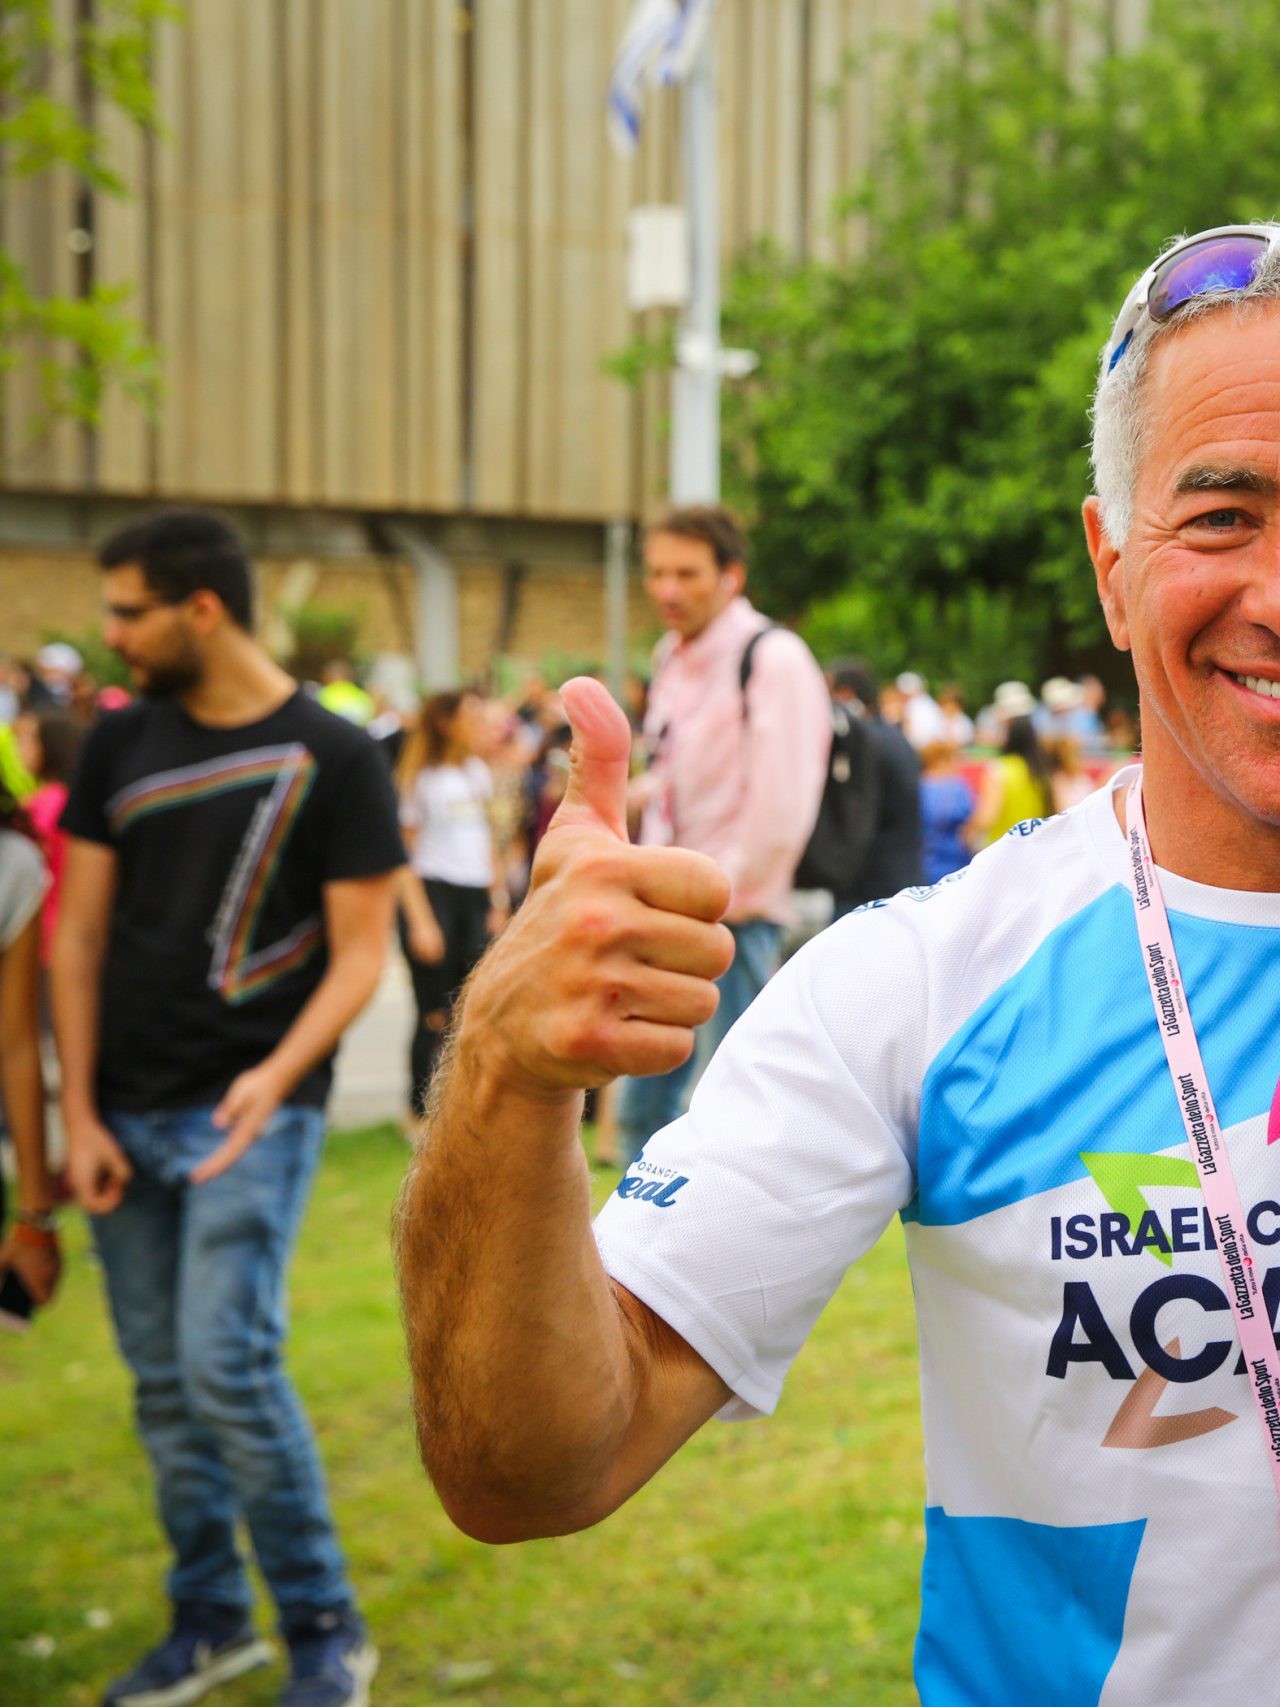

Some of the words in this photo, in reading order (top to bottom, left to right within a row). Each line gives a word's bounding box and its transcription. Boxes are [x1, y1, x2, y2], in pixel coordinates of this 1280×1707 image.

[1146, 942, 1165, 967] Sport
[1152, 966, 1168, 987] dello
[1177, 1073, 1197, 1101] Sport
[1185, 1099, 1202, 1122] dello
[1215, 1214, 1236, 1243] Sport
[1223, 1241, 1241, 1265] dello
[1250, 1358, 1271, 1387] Sport
[1258, 1385, 1276, 1409] dello
